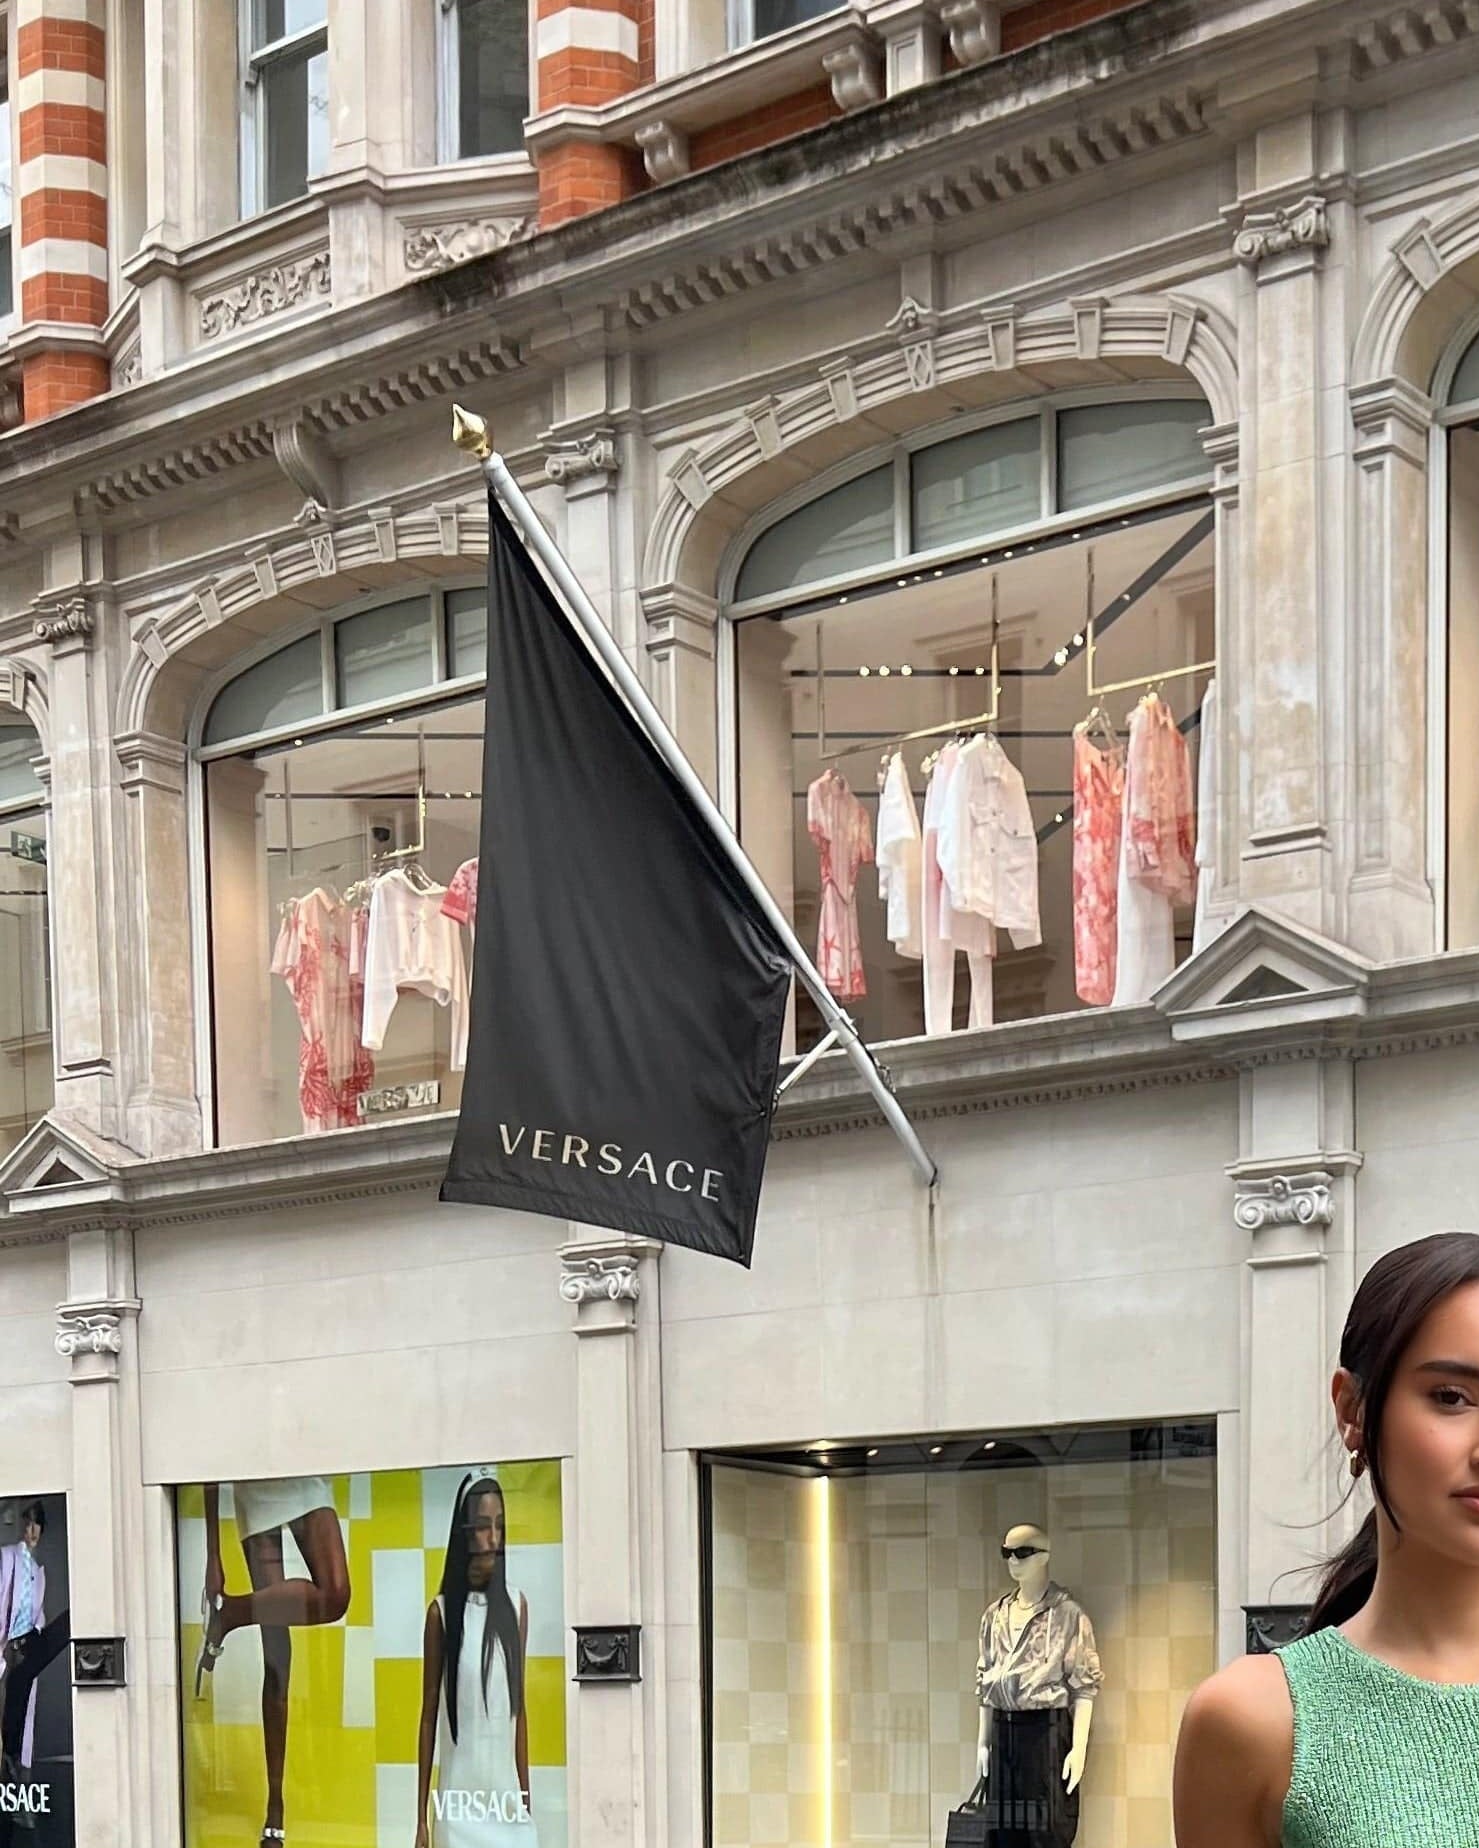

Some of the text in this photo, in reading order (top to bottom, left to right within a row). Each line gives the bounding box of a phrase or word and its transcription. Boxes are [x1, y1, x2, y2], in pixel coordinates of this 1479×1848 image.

[498, 1123, 724, 1202] VERSACE
[0, 1782, 51, 1813] RSACE
[431, 1789, 529, 1823] VERSACE
